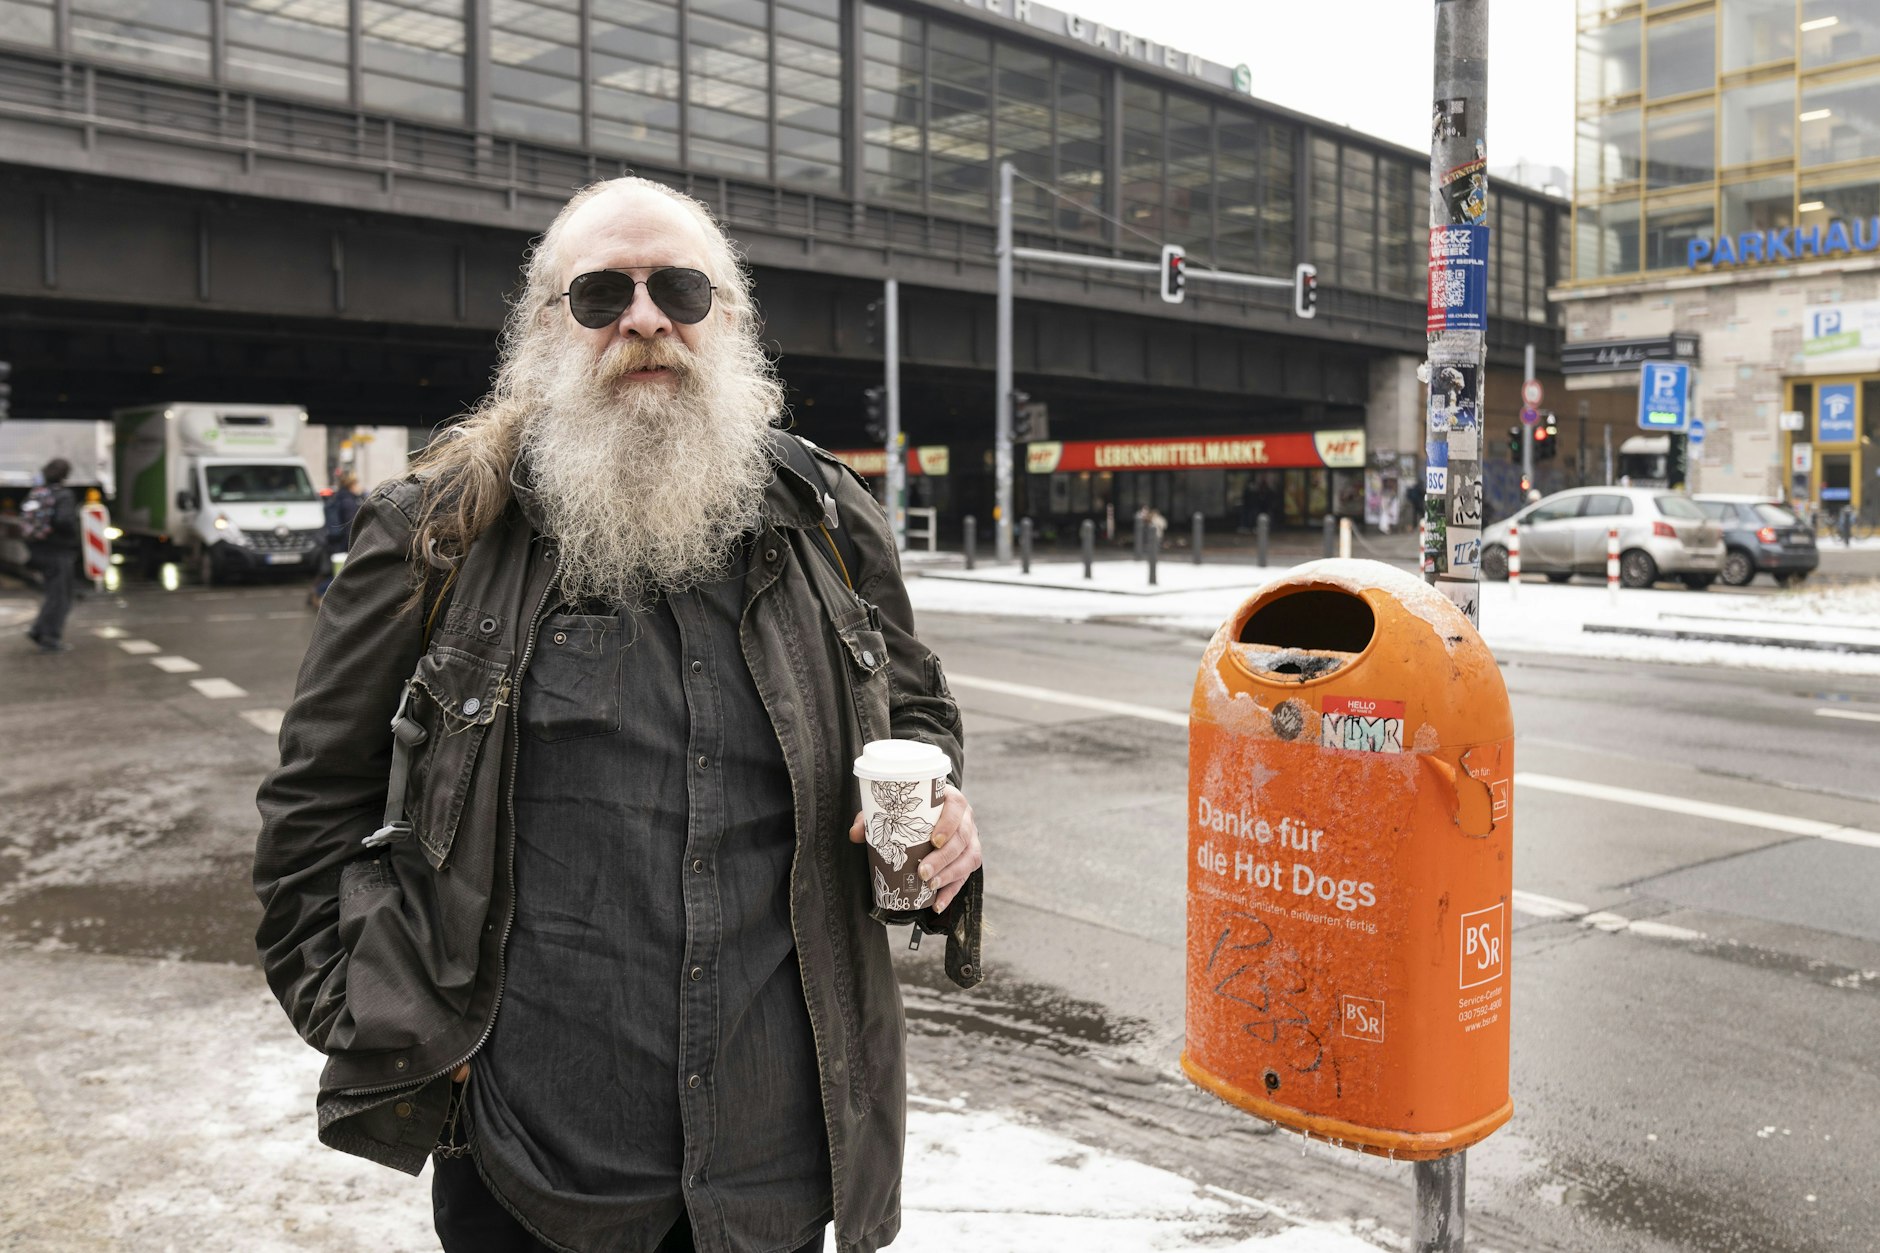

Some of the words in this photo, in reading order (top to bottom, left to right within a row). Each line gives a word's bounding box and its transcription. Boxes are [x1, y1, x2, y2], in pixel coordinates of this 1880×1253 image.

[1066, 13, 1202, 77] GARTEN
[1431, 248, 1470, 257] WEEK
[1095, 440, 1270, 468] LEBENSMITTELMARKT.
[1325, 439, 1359, 456] HIT
[1347, 700, 1377, 711] HELLO
[1198, 796, 1273, 844] Danke
[1279, 817, 1324, 853] für
[1197, 841, 1228, 876] die
[1234, 851, 1283, 891] Hot
[1292, 863, 1377, 912] Dogs
[1290, 909, 1343, 929] einwerfen,
[1345, 917, 1379, 935] fertig.
[1466, 922, 1500, 970] BSR
[1458, 986, 1503, 1009] Service-Center
[1458, 1009, 1473, 1022] 030
[1473, 997, 1503, 1018] 7592-4900
[1346, 1003, 1379, 1035] BSR
[1464, 1013, 1498, 1033] www.bsr.de
